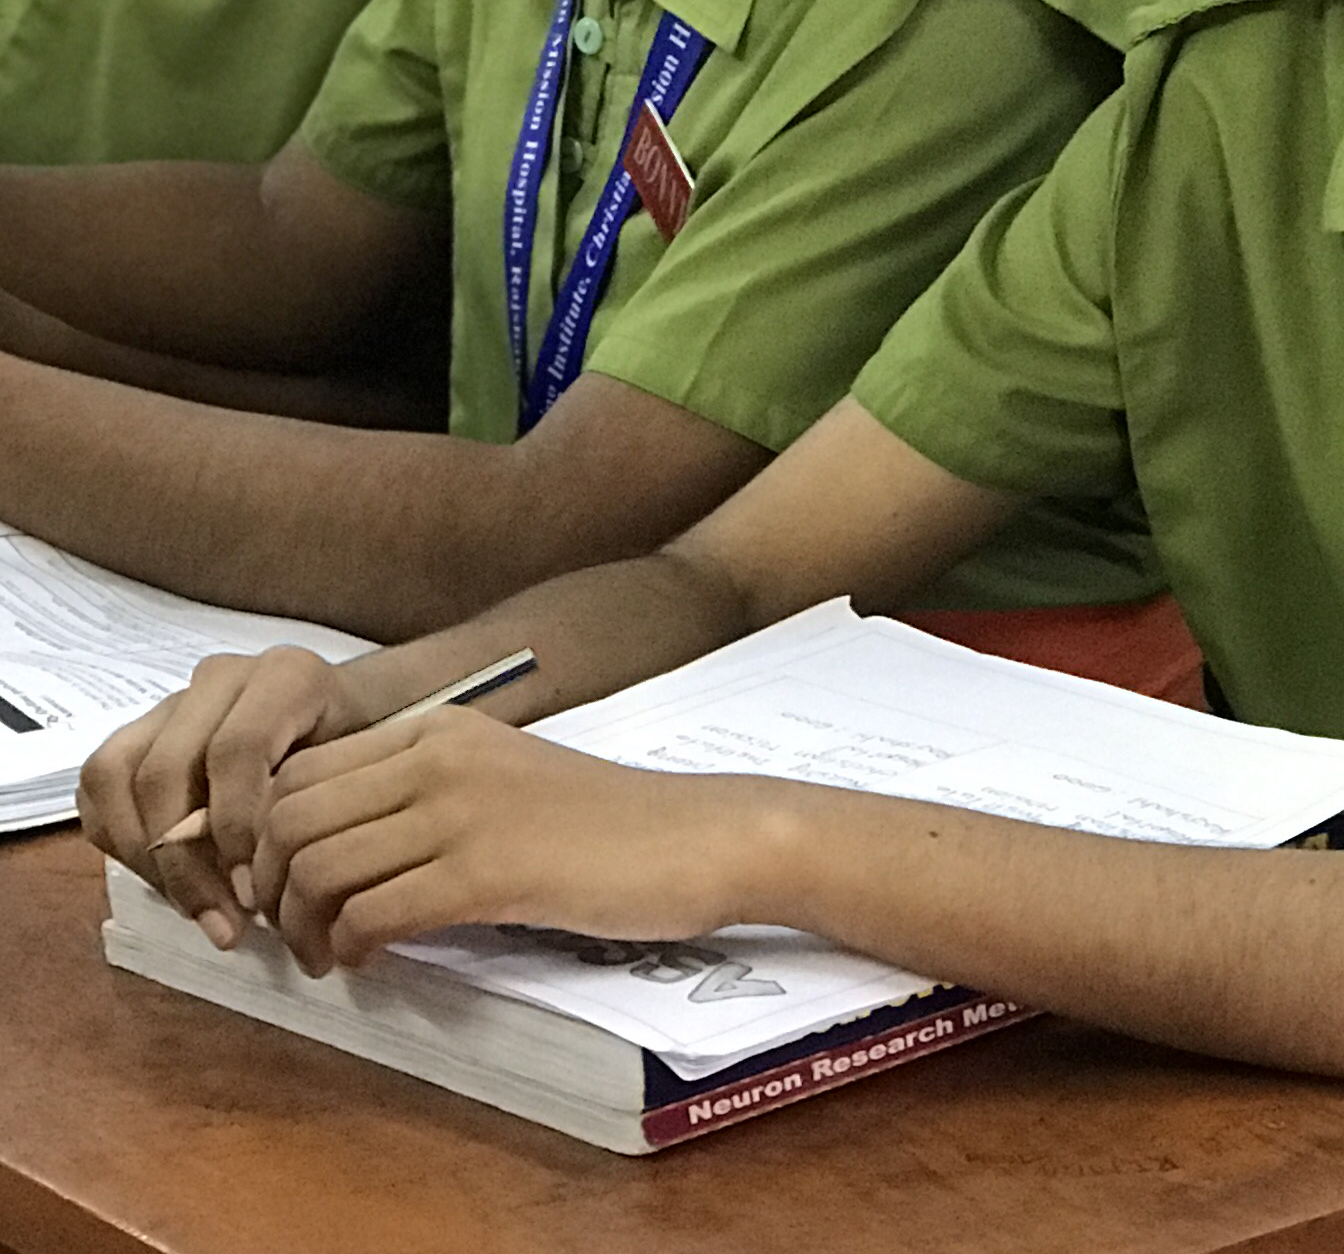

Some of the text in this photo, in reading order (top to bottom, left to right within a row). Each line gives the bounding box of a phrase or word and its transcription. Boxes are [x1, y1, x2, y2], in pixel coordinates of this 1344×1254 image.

[529, 33, 564, 130] Mission
[585, 170, 631, 267] Christia
[687, 1071, 803, 1124] Neuron
[810, 1016, 954, 1082] Research
